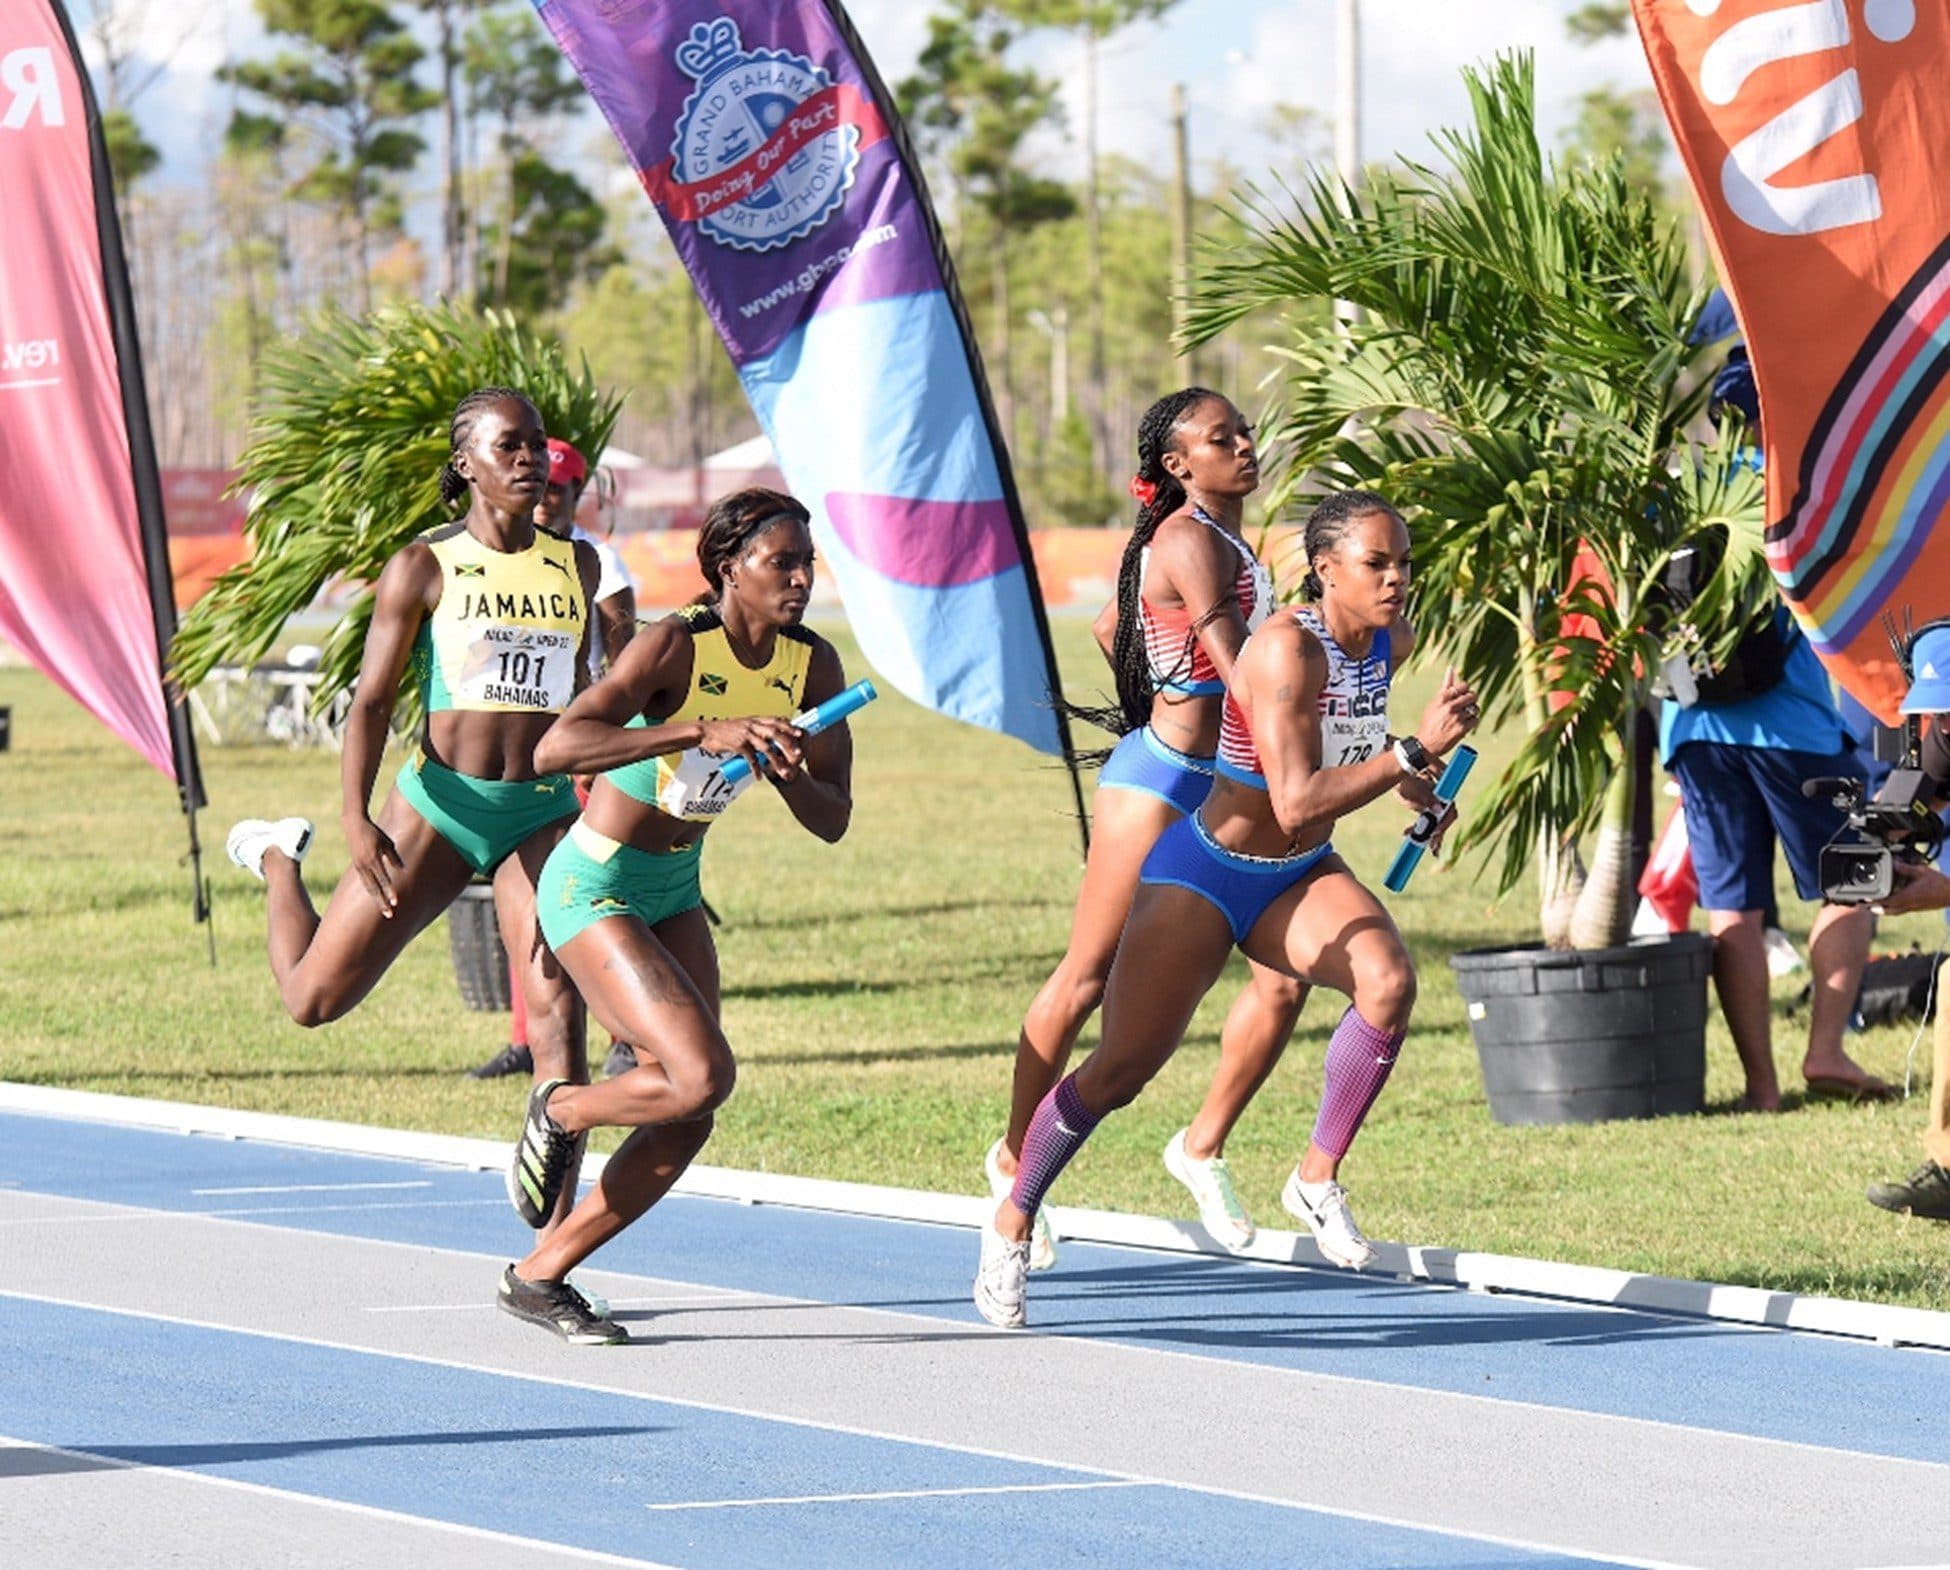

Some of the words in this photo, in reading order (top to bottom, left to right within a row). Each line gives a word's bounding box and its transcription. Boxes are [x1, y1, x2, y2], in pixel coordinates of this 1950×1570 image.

[693, 94, 727, 175] GRAND
[729, 70, 816, 99] BAHAMA
[694, 170, 756, 213] Doing
[757, 136, 786, 170] Our
[789, 102, 837, 140] Part
[718, 206, 761, 228] ORT
[456, 592, 581, 622] JAMAICA
[498, 651, 546, 688] 101
[483, 684, 550, 709] BAHAMAS
